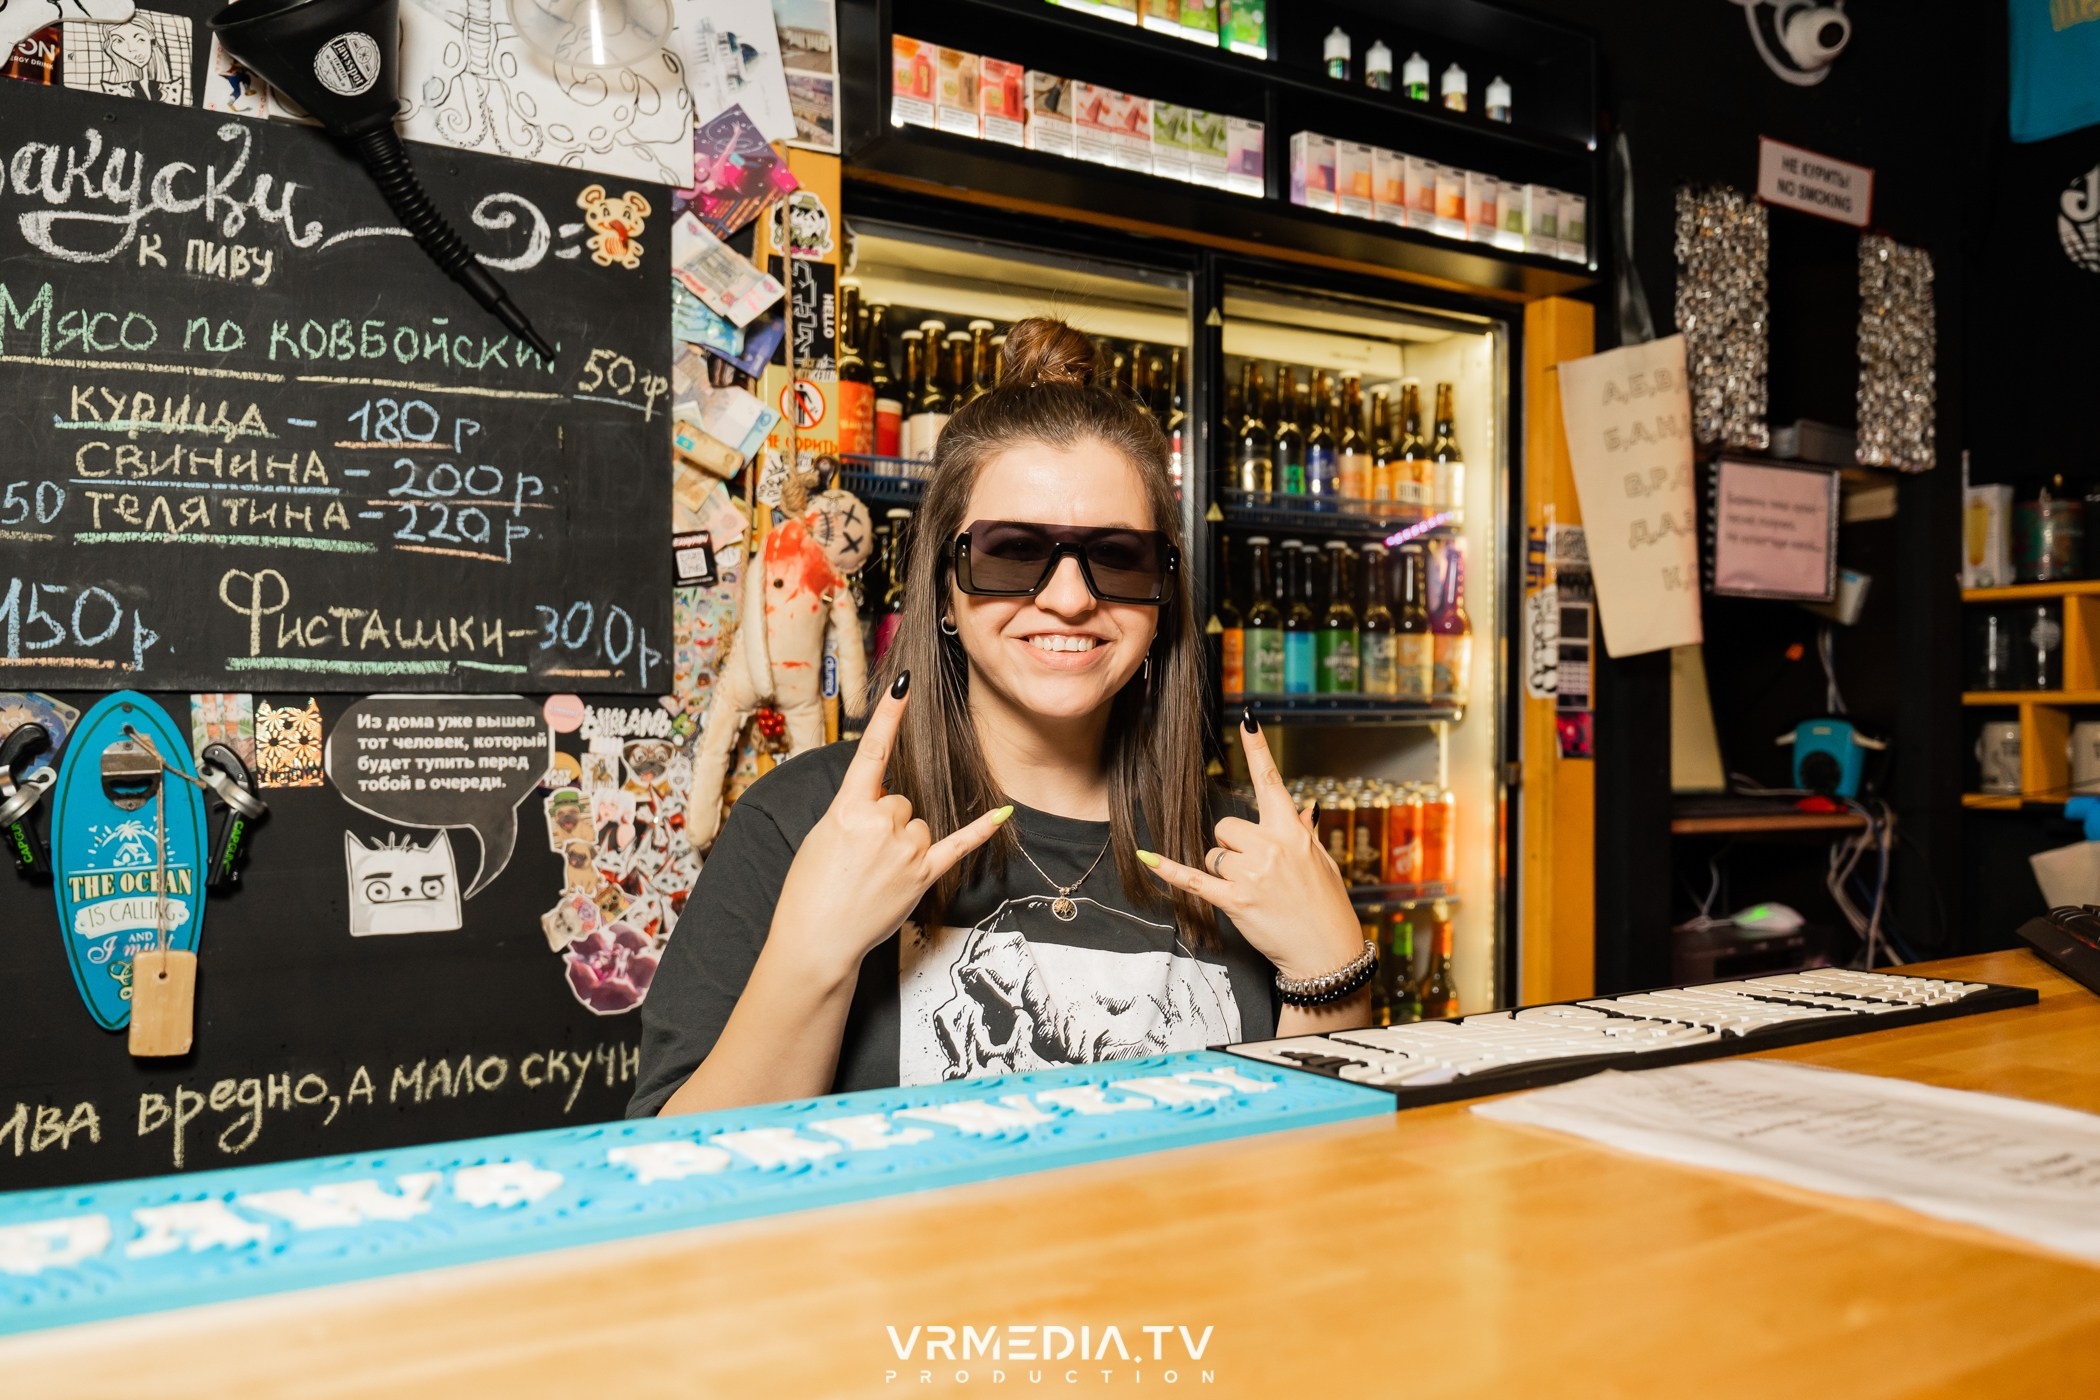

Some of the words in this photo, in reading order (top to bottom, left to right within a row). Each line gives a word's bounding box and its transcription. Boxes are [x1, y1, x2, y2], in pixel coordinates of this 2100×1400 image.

[31, 58, 54, 70] DRINK
[1781, 156, 1798, 175] НЕ
[1801, 160, 1852, 190] КУРИТЬ
[0, 122, 324, 264] акуски
[1777, 177, 1796, 197] NO
[1798, 182, 1853, 214] SMOKING
[821, 293, 836, 339] HELLO
[70, 384, 272, 441] КУРИЦА
[347, 397, 441, 443] 180
[75, 440, 331, 485] СВИНИНА
[388, 457, 504, 498] 200
[393, 502, 491, 543] 220
[357, 713, 383, 729] Из
[386, 715, 435, 732] дома
[437, 715, 474, 732] уже
[476, 715, 536, 729] вышел
[357, 736, 389, 751] тот
[392, 736, 470, 751] человек,
[473, 732, 548, 751] который
[357, 755, 412, 775] будет
[414, 756, 476, 774] тупить
[478, 755, 530, 771] перед
[357, 775, 412, 792] тобой
[414, 778, 427, 791] в
[429, 776, 508, 793] очереди.
[68, 873, 116, 904] THE
[119, 867, 193, 897] OCEAN
[87, 905, 107, 929] IS
[109, 899, 177, 923] CALLING
[86, 934, 119, 965] I
[123, 933, 176, 958] mut
[127, 930, 154, 944] AND
[389, 1053, 509, 1106] МАЛО
[519, 1041, 640, 1115] СКУЧН
